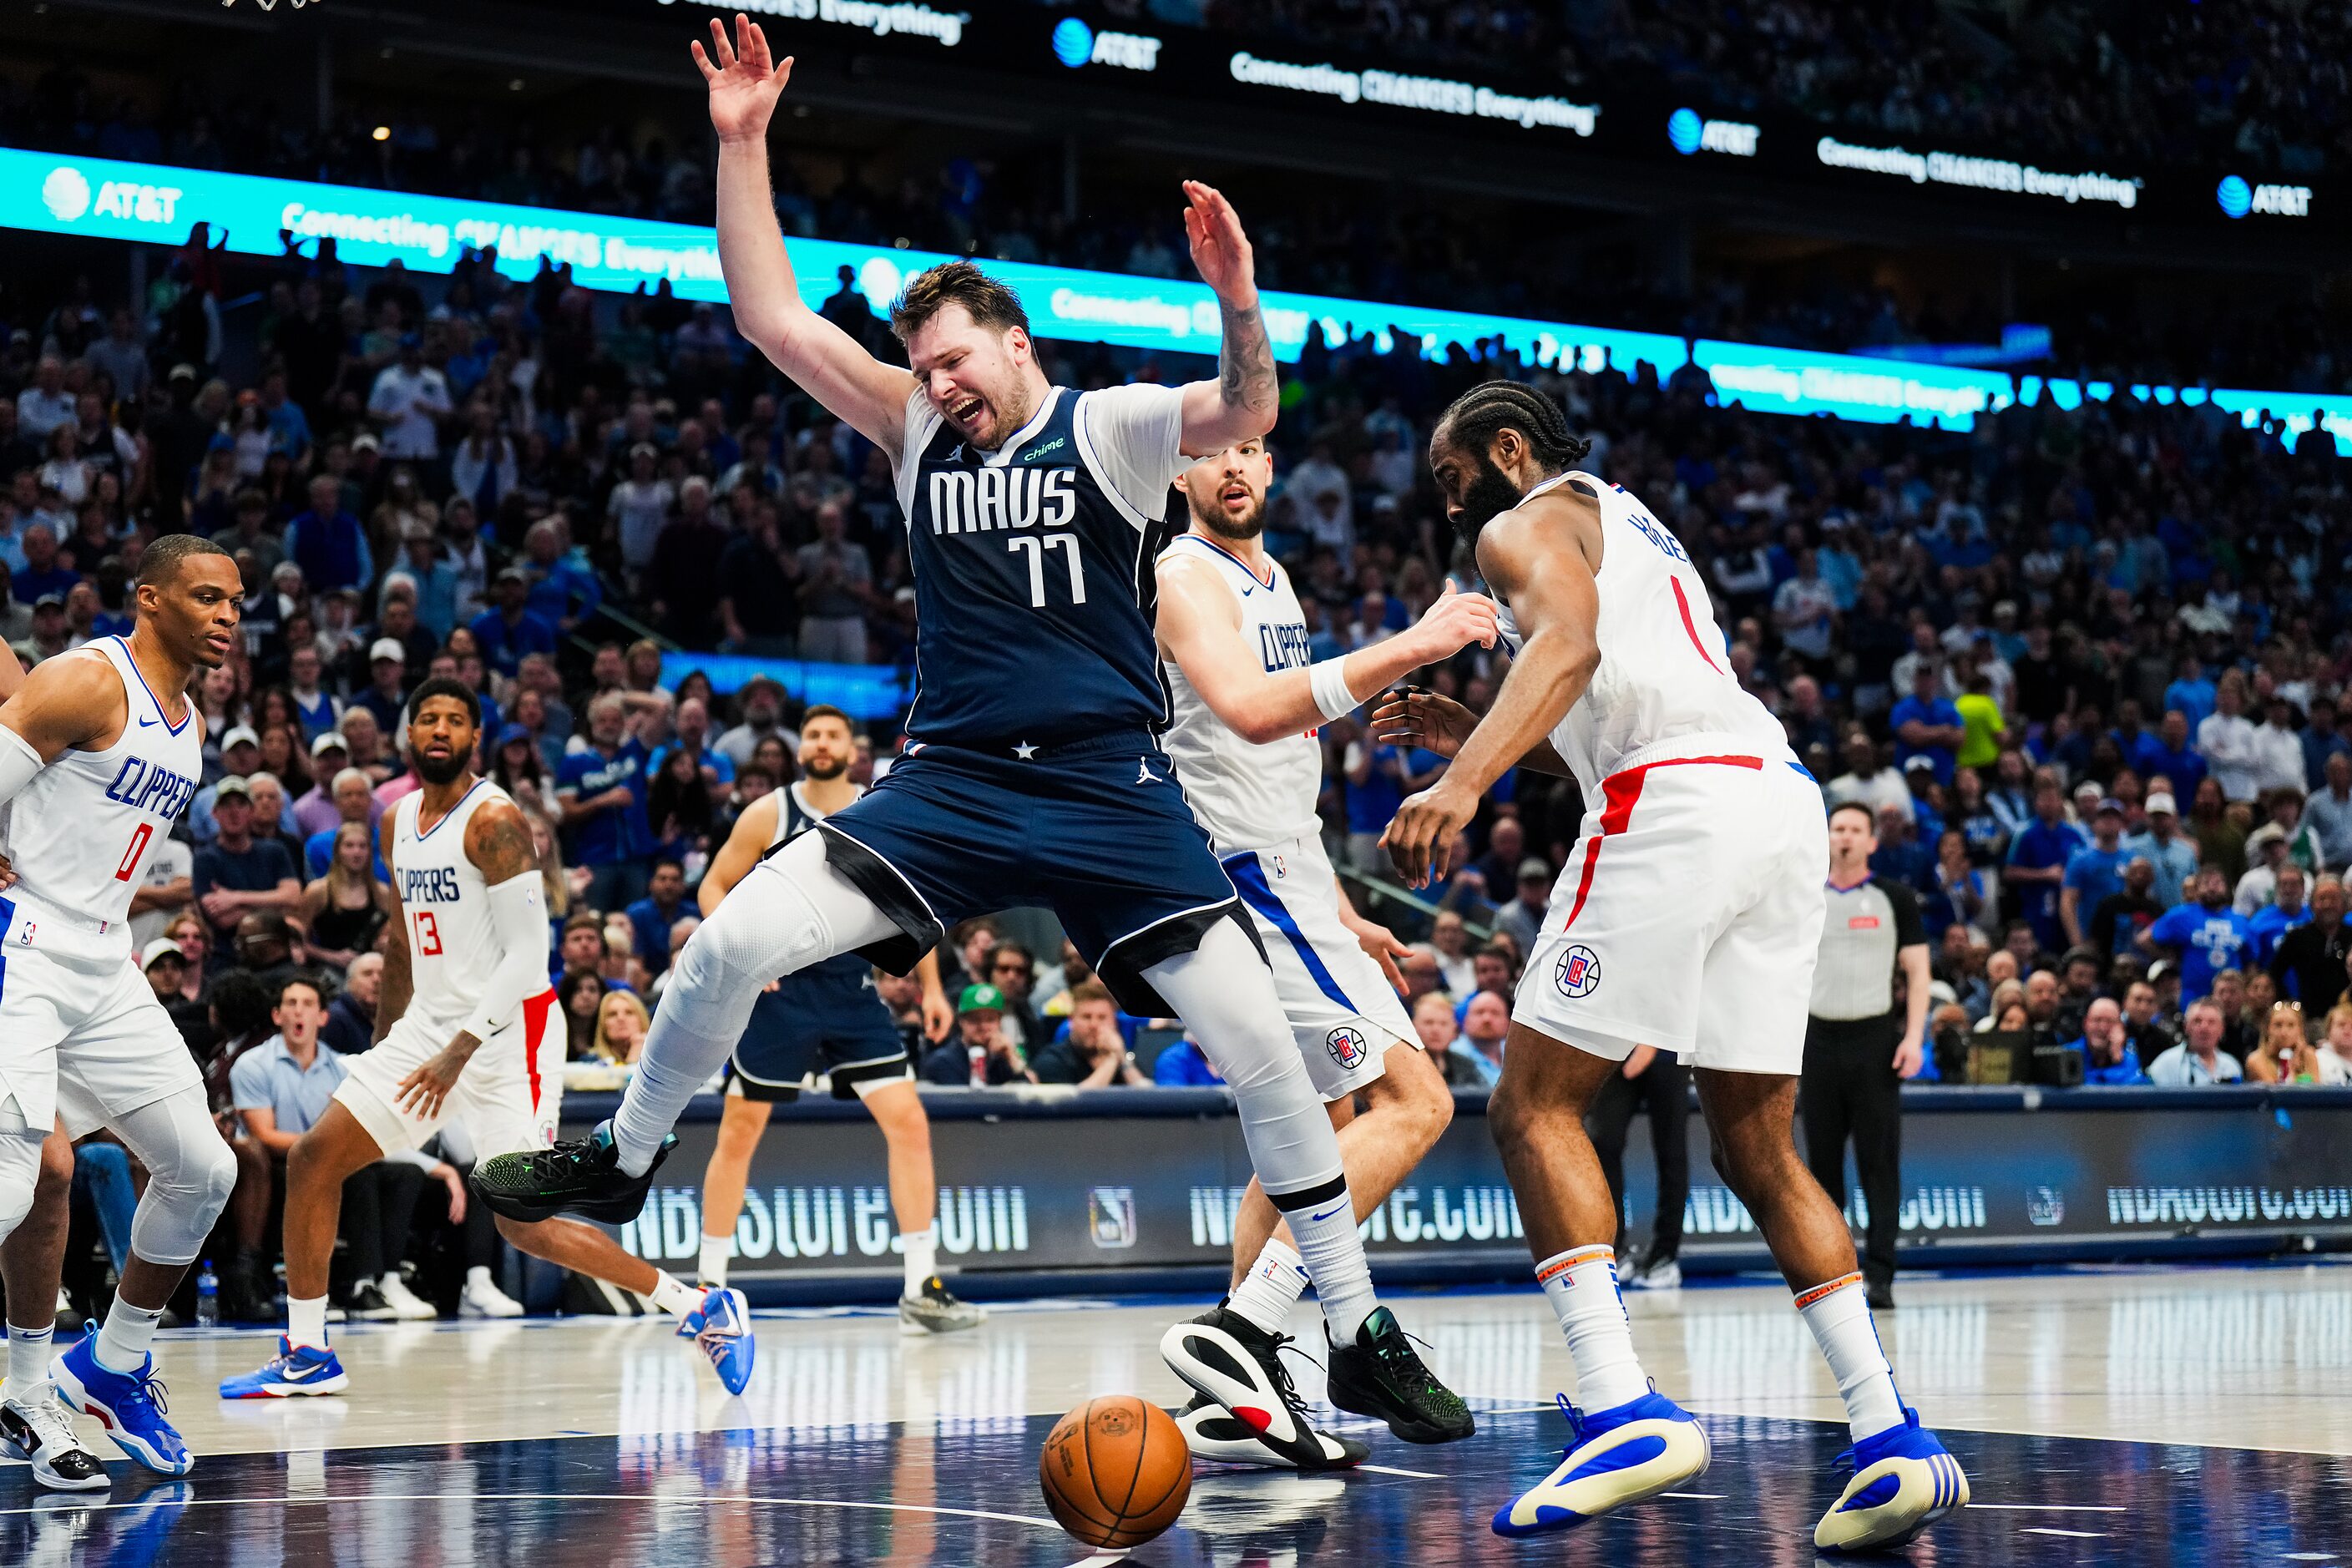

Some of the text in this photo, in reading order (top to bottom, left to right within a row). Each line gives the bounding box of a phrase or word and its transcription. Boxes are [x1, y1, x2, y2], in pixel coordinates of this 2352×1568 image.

[1092, 31, 1161, 72] AT&T
[1701, 119, 1760, 156] AT&T
[94, 181, 183, 224] AT&T
[2251, 183, 2313, 217] AT&T
[1024, 438, 1065, 462] chime
[929, 466, 1076, 535] MAVS
[1008, 532, 1086, 609] 77
[1670, 574, 1725, 676] 1
[114, 822, 154, 883] 0
[412, 912, 443, 957] 13
